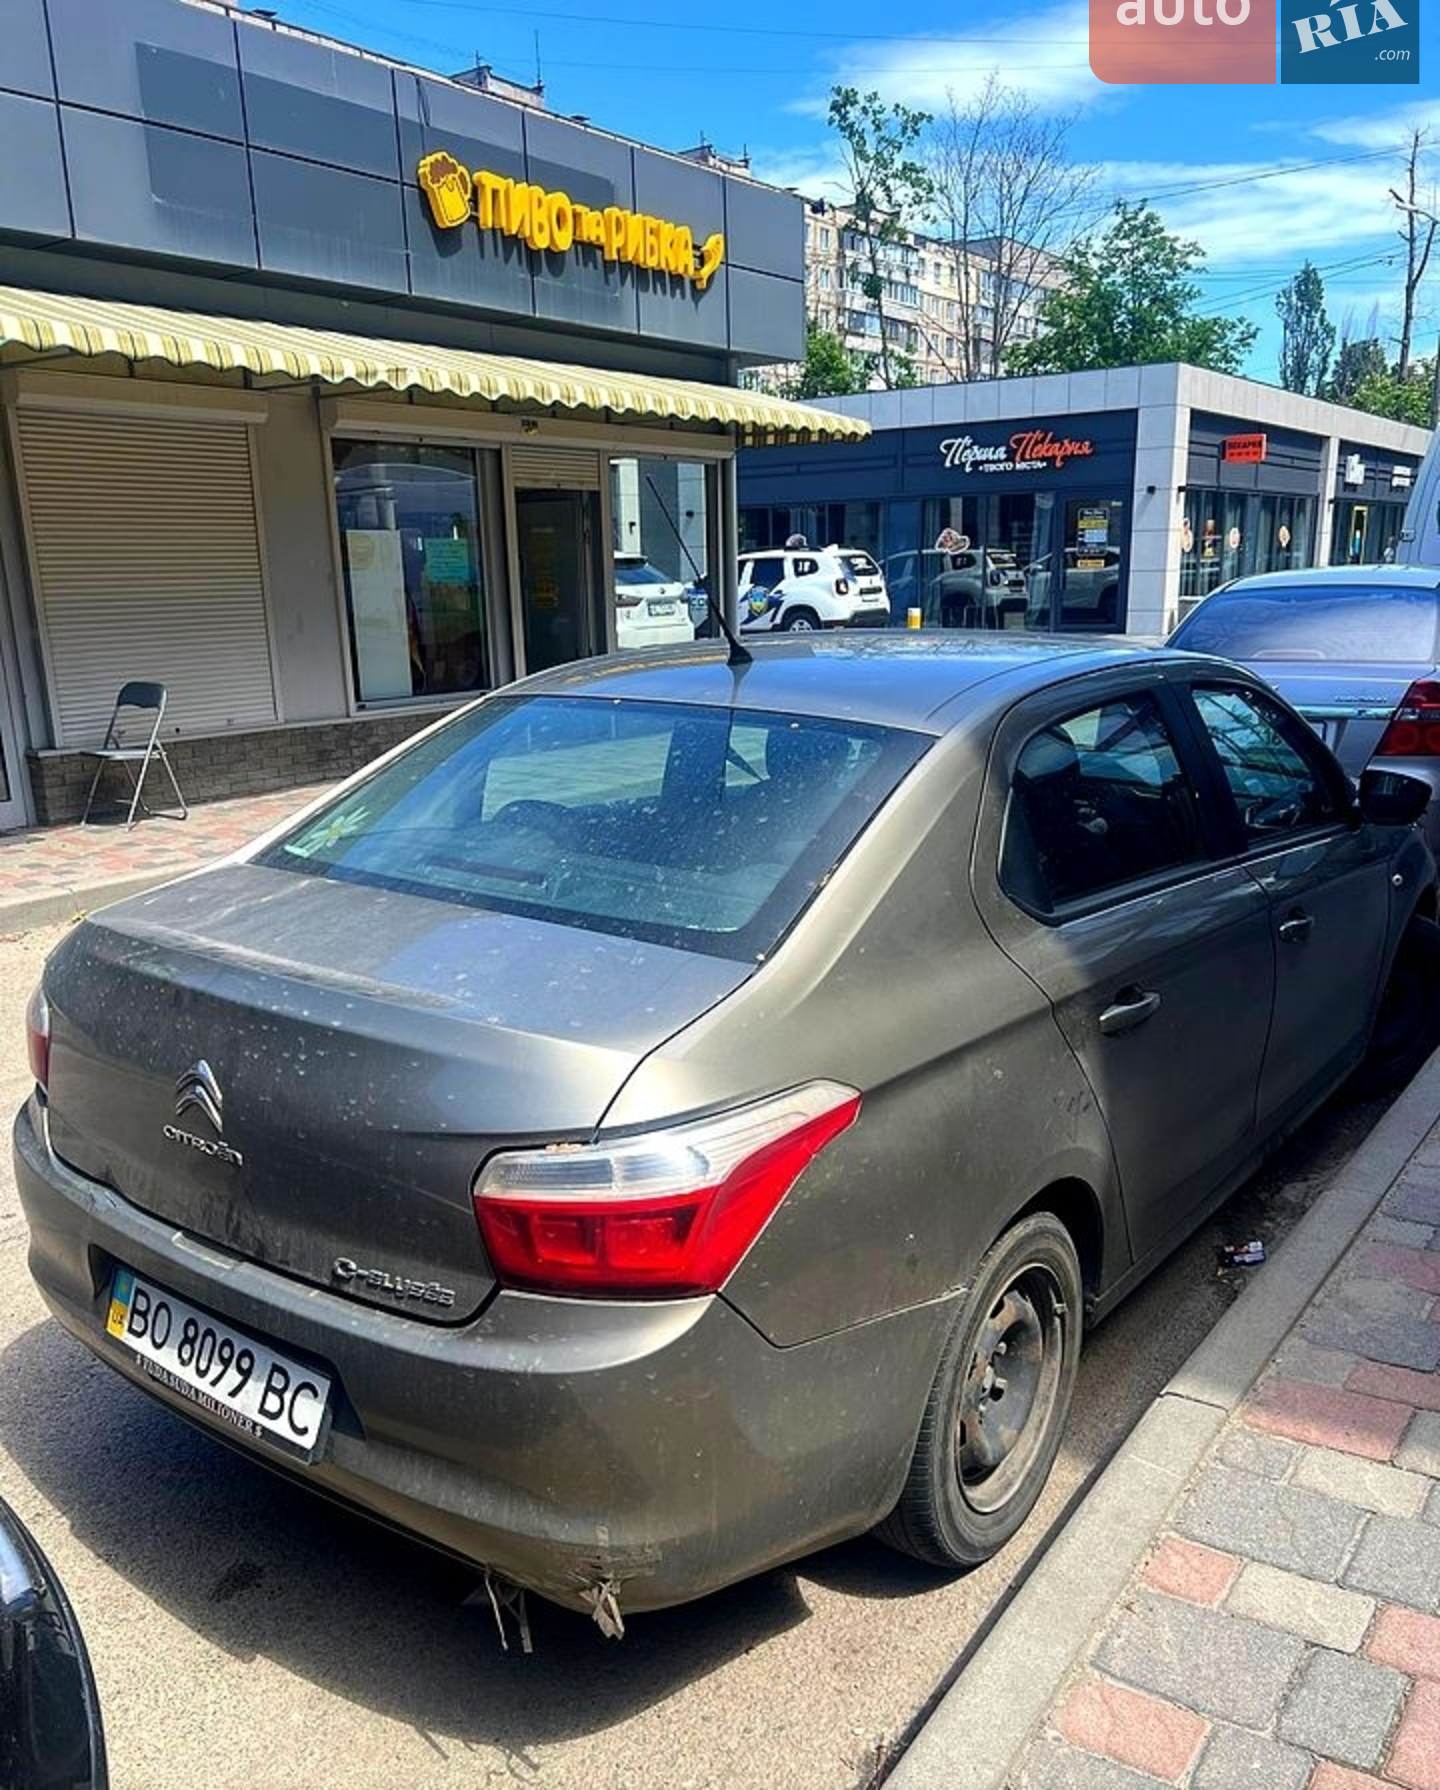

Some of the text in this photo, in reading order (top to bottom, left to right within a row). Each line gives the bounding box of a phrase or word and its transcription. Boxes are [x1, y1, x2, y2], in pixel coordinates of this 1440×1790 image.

[472, 170, 574, 252] ПИВО
[603, 206, 698, 278] РИБКА
[939, 429, 1094, 473] Перша Пекарня
[177, 1317, 255, 1398] 8099
